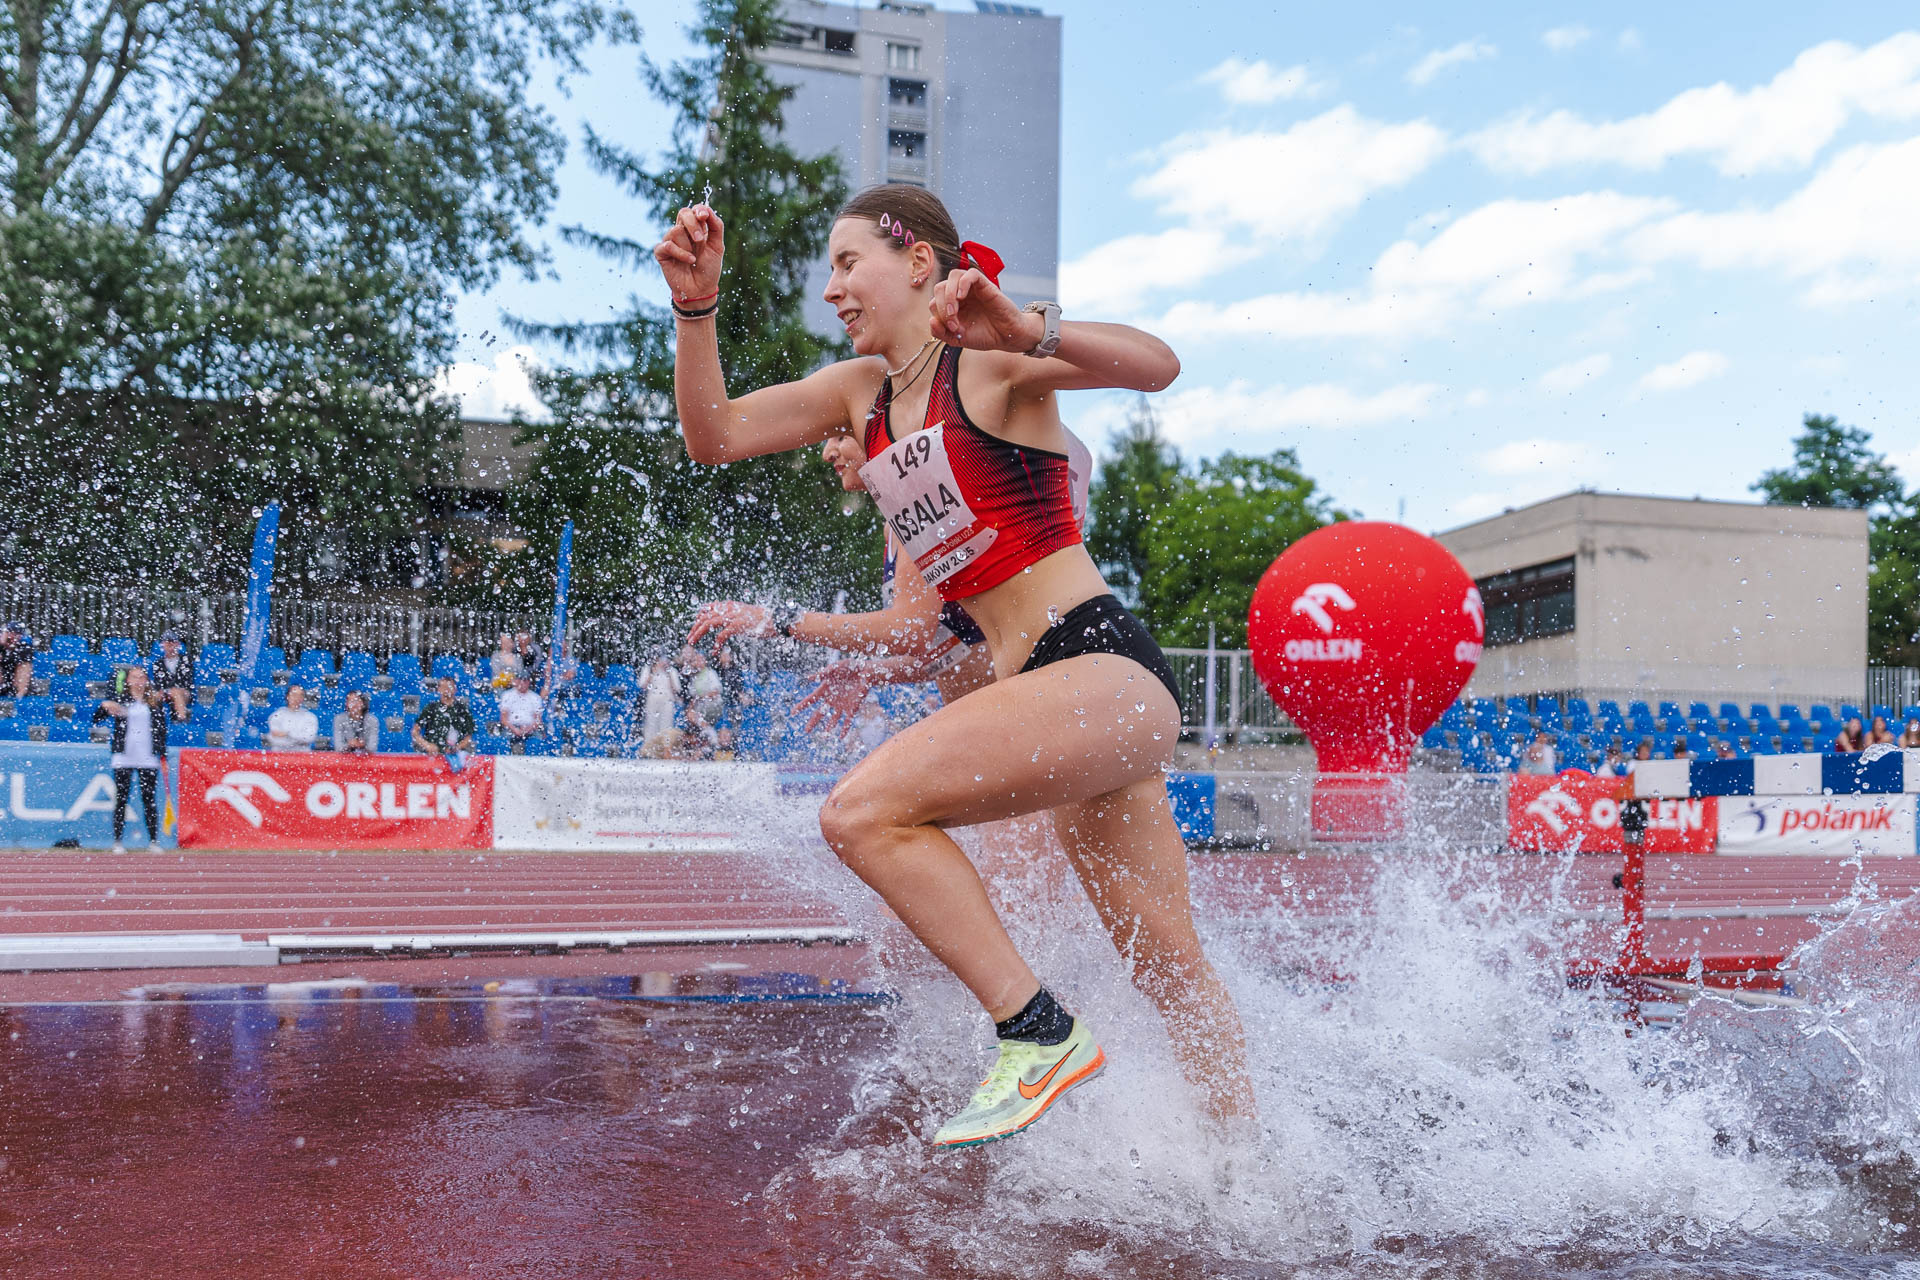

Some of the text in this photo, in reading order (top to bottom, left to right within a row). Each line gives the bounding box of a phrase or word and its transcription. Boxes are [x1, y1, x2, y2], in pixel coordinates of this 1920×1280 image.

[891, 435, 931, 480] 149
[888, 482, 961, 546] ISSALA
[1284, 637, 1363, 662] ORLEN
[0, 772, 139, 820] LA
[305, 780, 472, 819] ORLEN
[1591, 798, 1703, 829] OLEN
[1778, 802, 1894, 837] polanik
